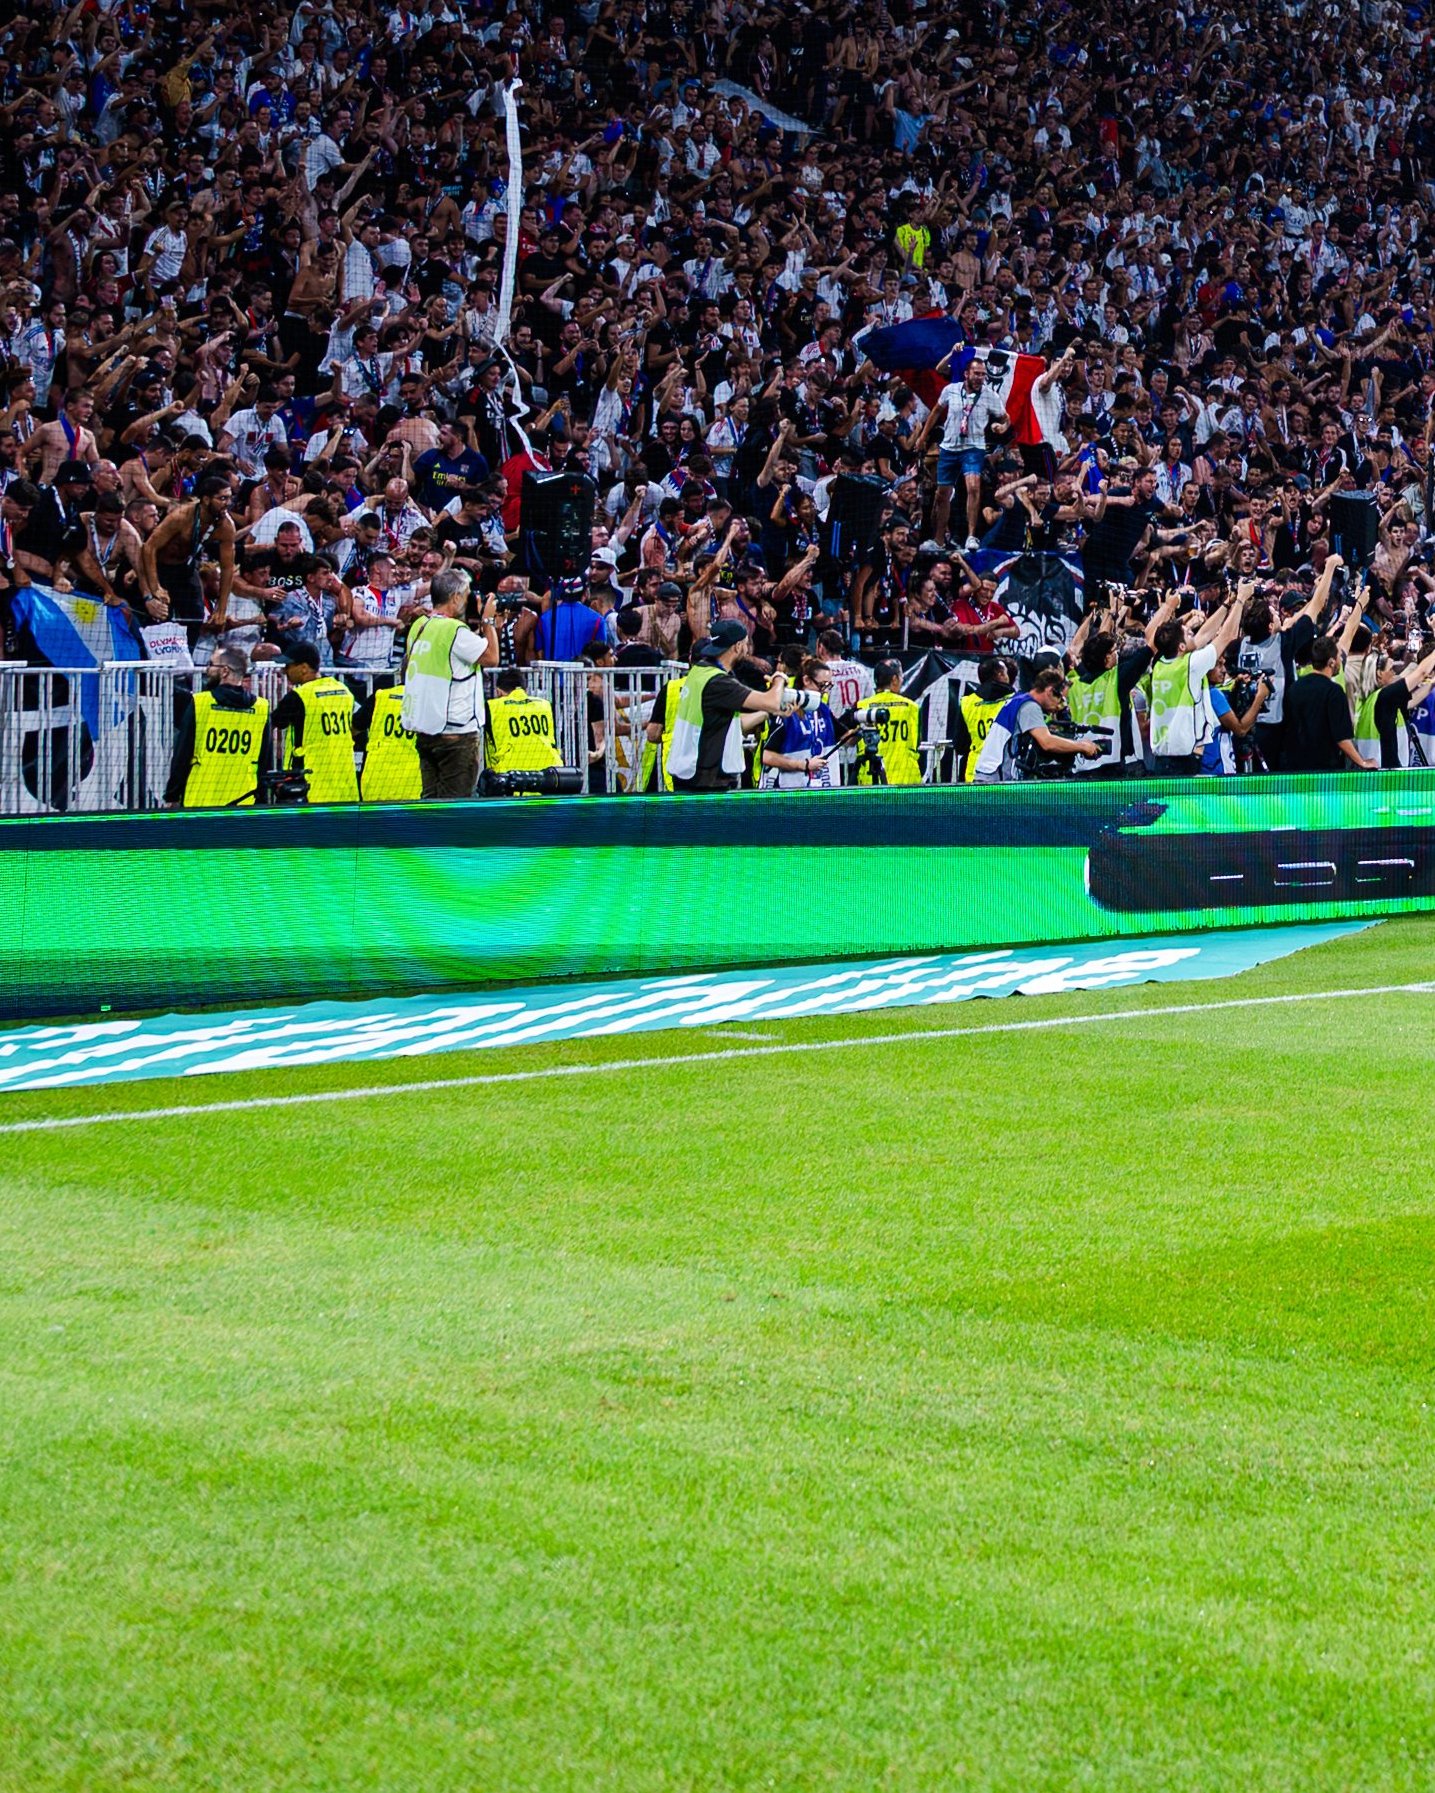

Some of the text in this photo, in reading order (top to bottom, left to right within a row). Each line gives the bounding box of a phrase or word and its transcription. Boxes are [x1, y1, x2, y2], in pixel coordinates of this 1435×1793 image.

[268, 575, 304, 587] BOSS
[838, 678, 861, 708] 10
[508, 714, 551, 739] 0300
[878, 719, 910, 743] 370
[206, 726, 252, 756] 0209
